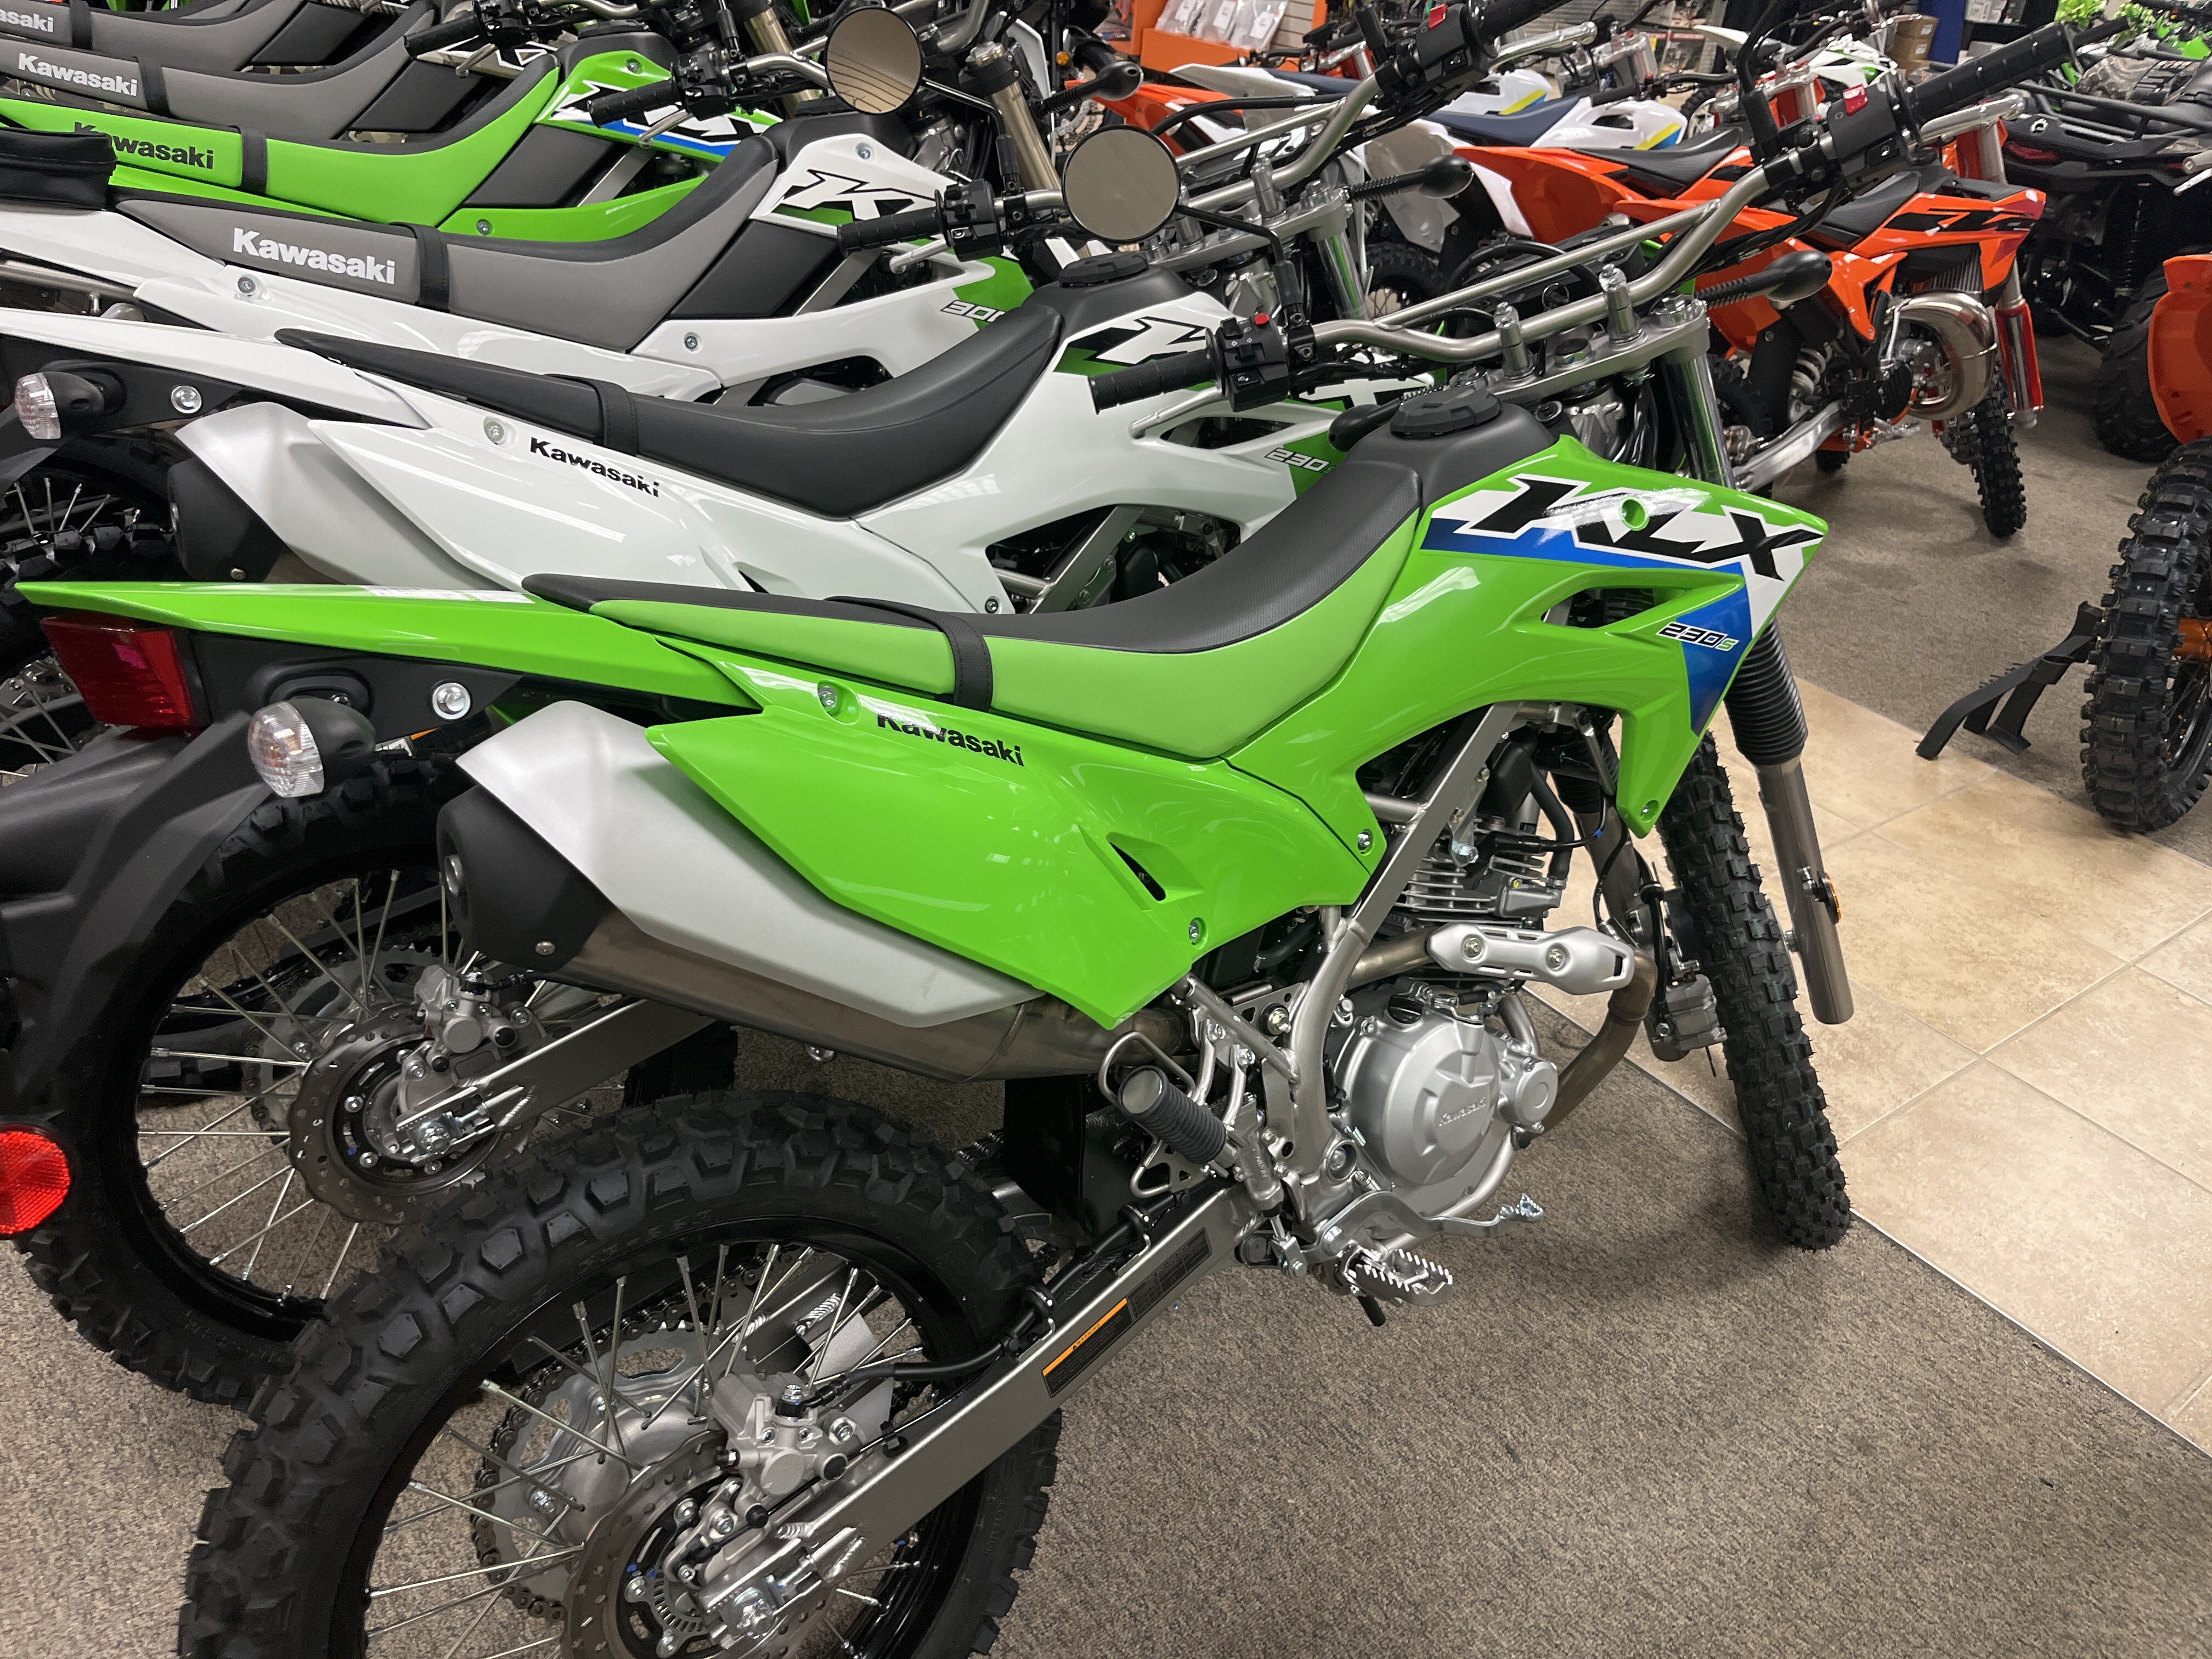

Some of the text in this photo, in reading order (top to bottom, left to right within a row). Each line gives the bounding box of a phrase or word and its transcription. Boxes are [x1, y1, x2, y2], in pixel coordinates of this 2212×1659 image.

[18, 52, 138, 97] Kawasaki
[74, 121, 214, 170] Kwasaki
[233, 227, 395, 279] Kawasaki
[530, 437, 659, 498] Kawasaki
[1468, 476, 1826, 583] KLX
[877, 713, 1025, 768] Kawasaki
